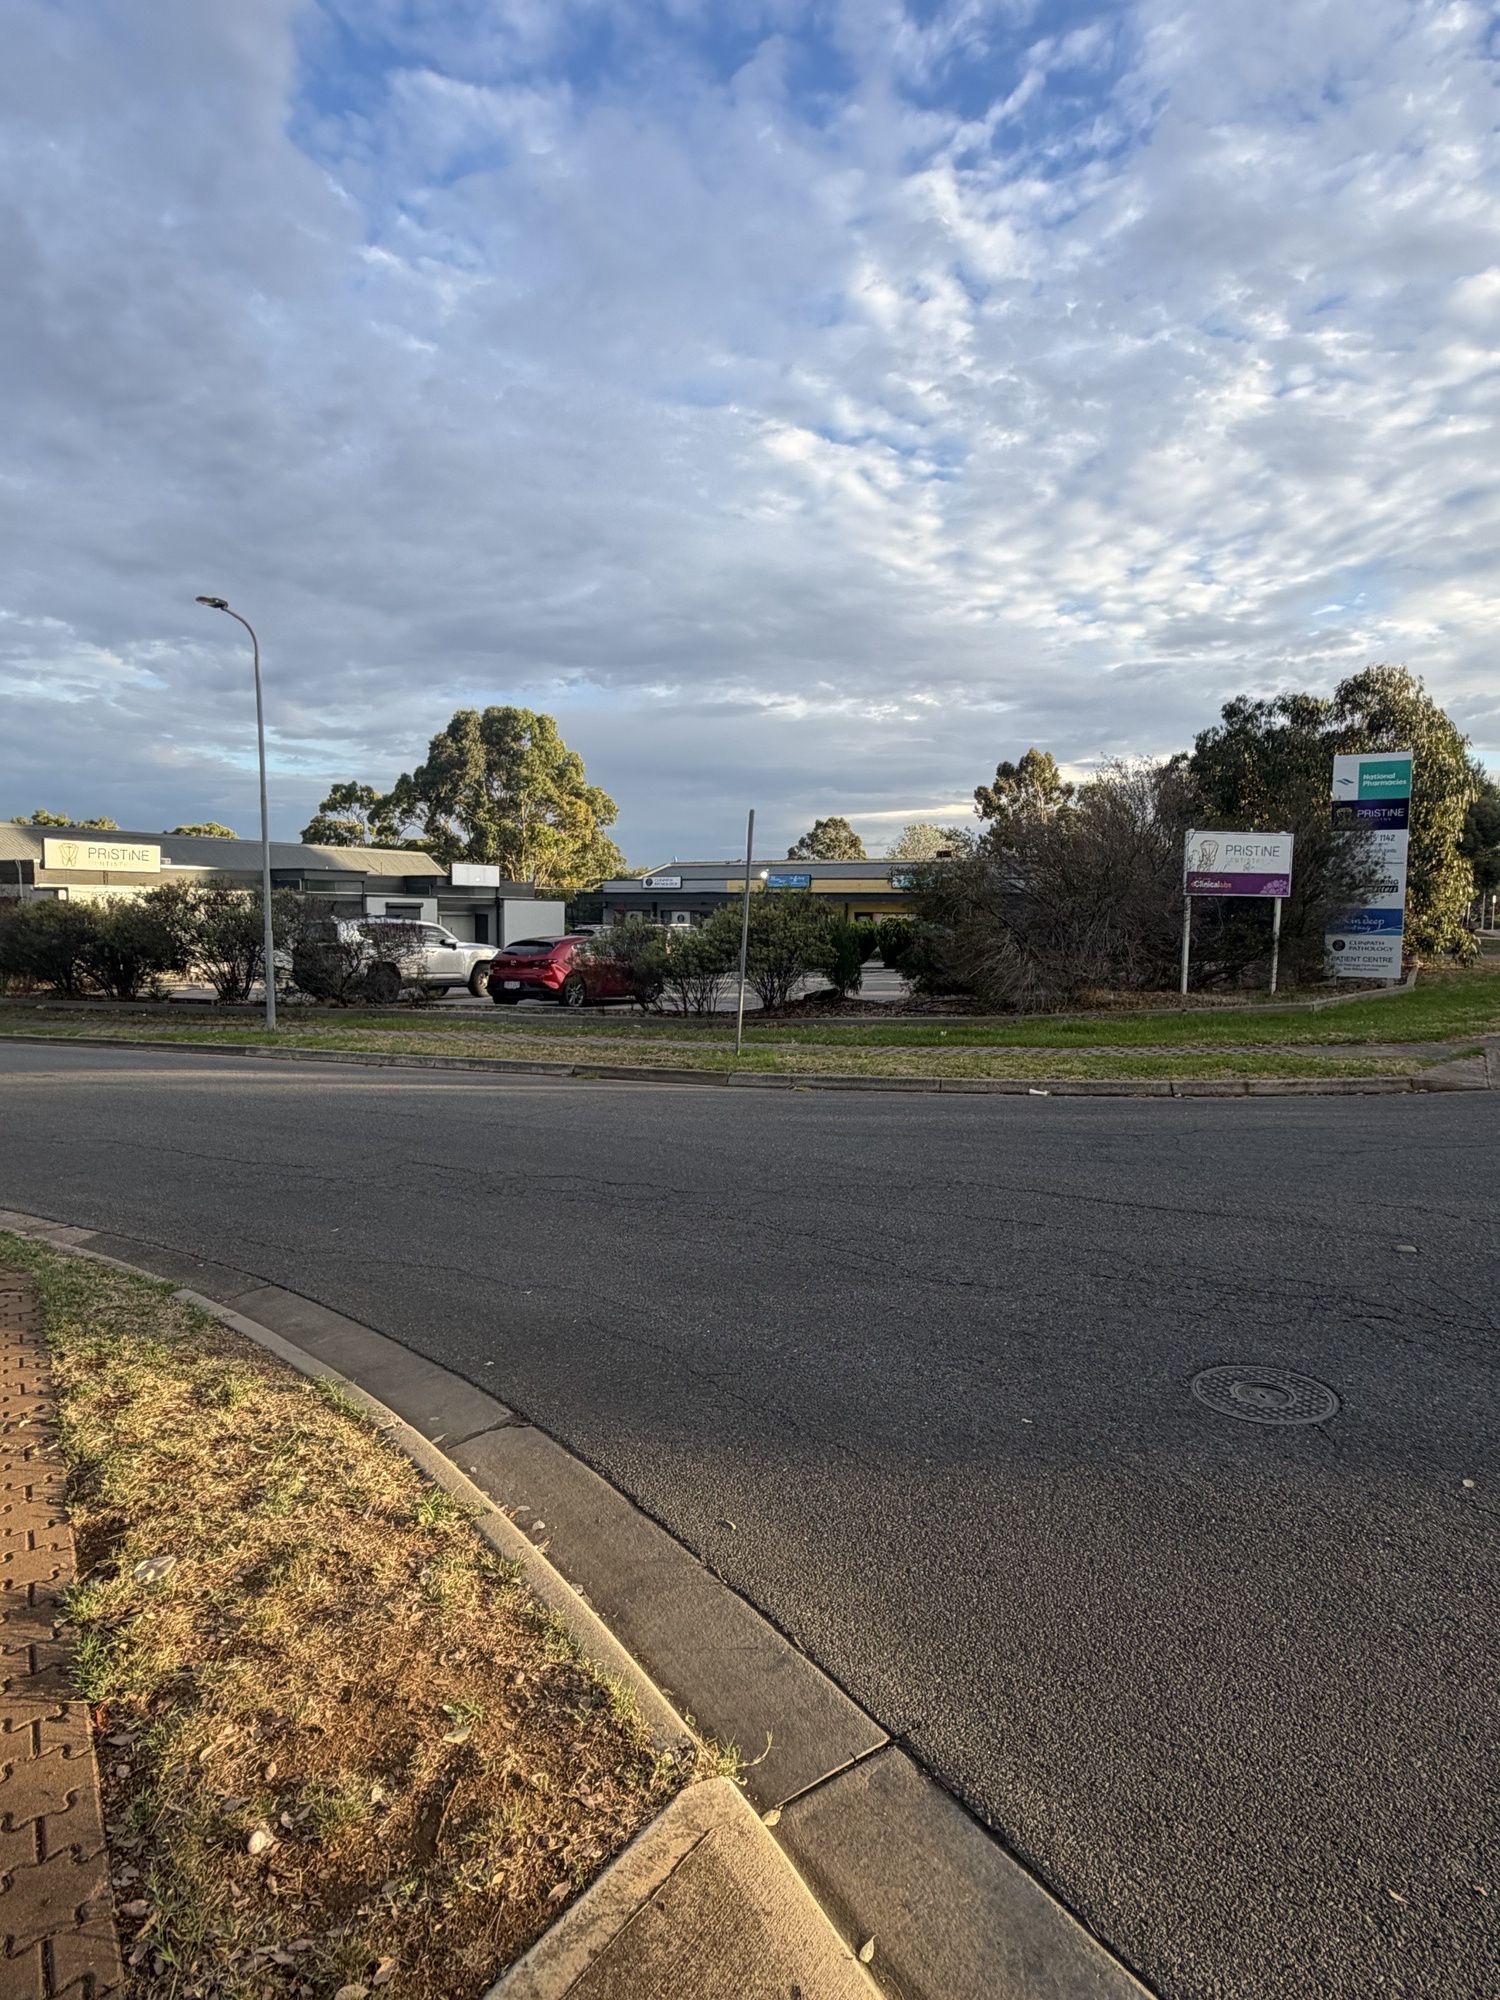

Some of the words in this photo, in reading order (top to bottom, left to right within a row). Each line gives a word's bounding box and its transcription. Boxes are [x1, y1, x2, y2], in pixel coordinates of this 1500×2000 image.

[1362, 772, 1396, 780] National
[1362, 779, 1407, 787] Pharmacies
[1379, 833, 1396, 842] 1142
[1331, 955, 1361, 963] PATIENT
[1362, 956, 1394, 964] CENTRE
